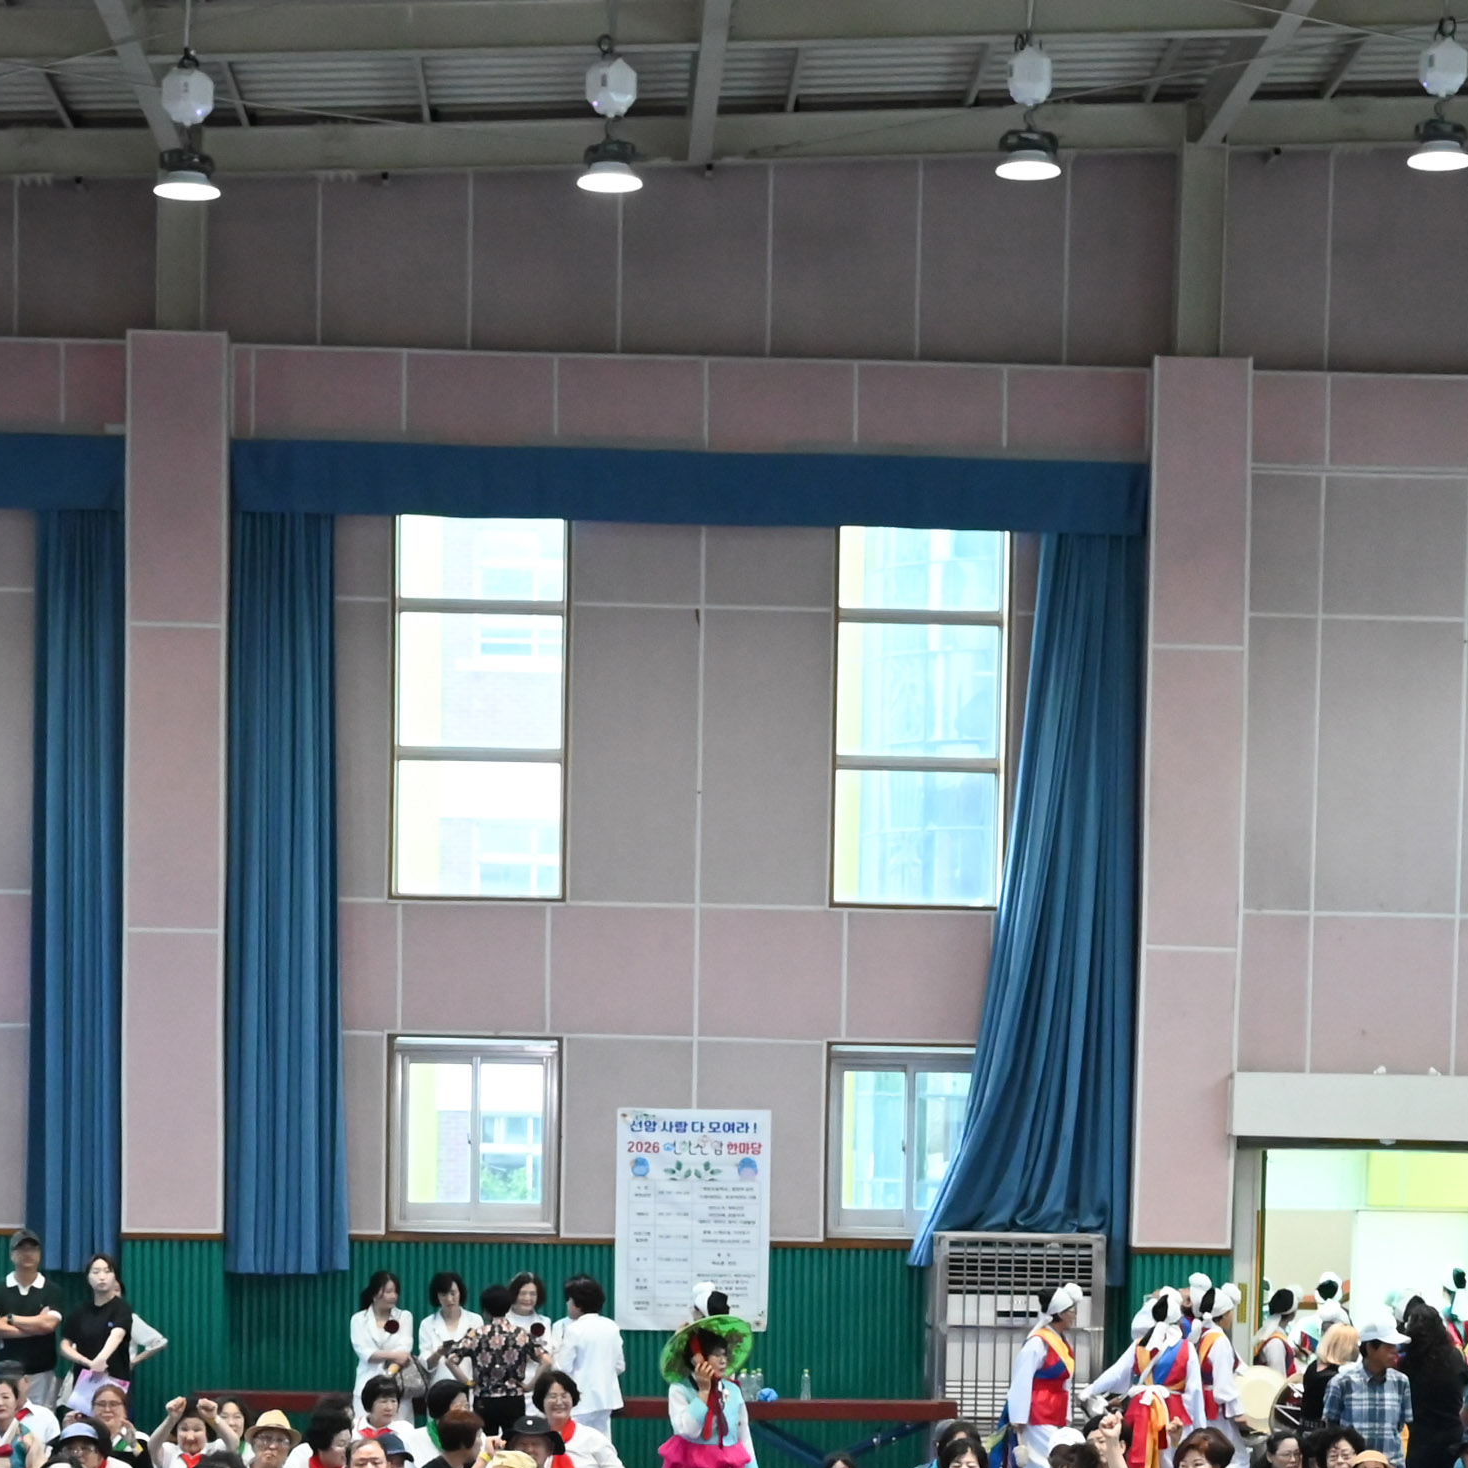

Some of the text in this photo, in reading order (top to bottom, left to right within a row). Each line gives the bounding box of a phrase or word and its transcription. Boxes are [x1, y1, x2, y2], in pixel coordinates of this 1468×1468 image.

[630, 1120, 657, 1133] 선암
[660, 1120, 688, 1133] 사람
[691, 1121, 705, 1133] 다
[708, 1121, 750, 1133] 모여라
[627, 1141, 660, 1154] 2026
[727, 1141, 762, 1155] 한마당
